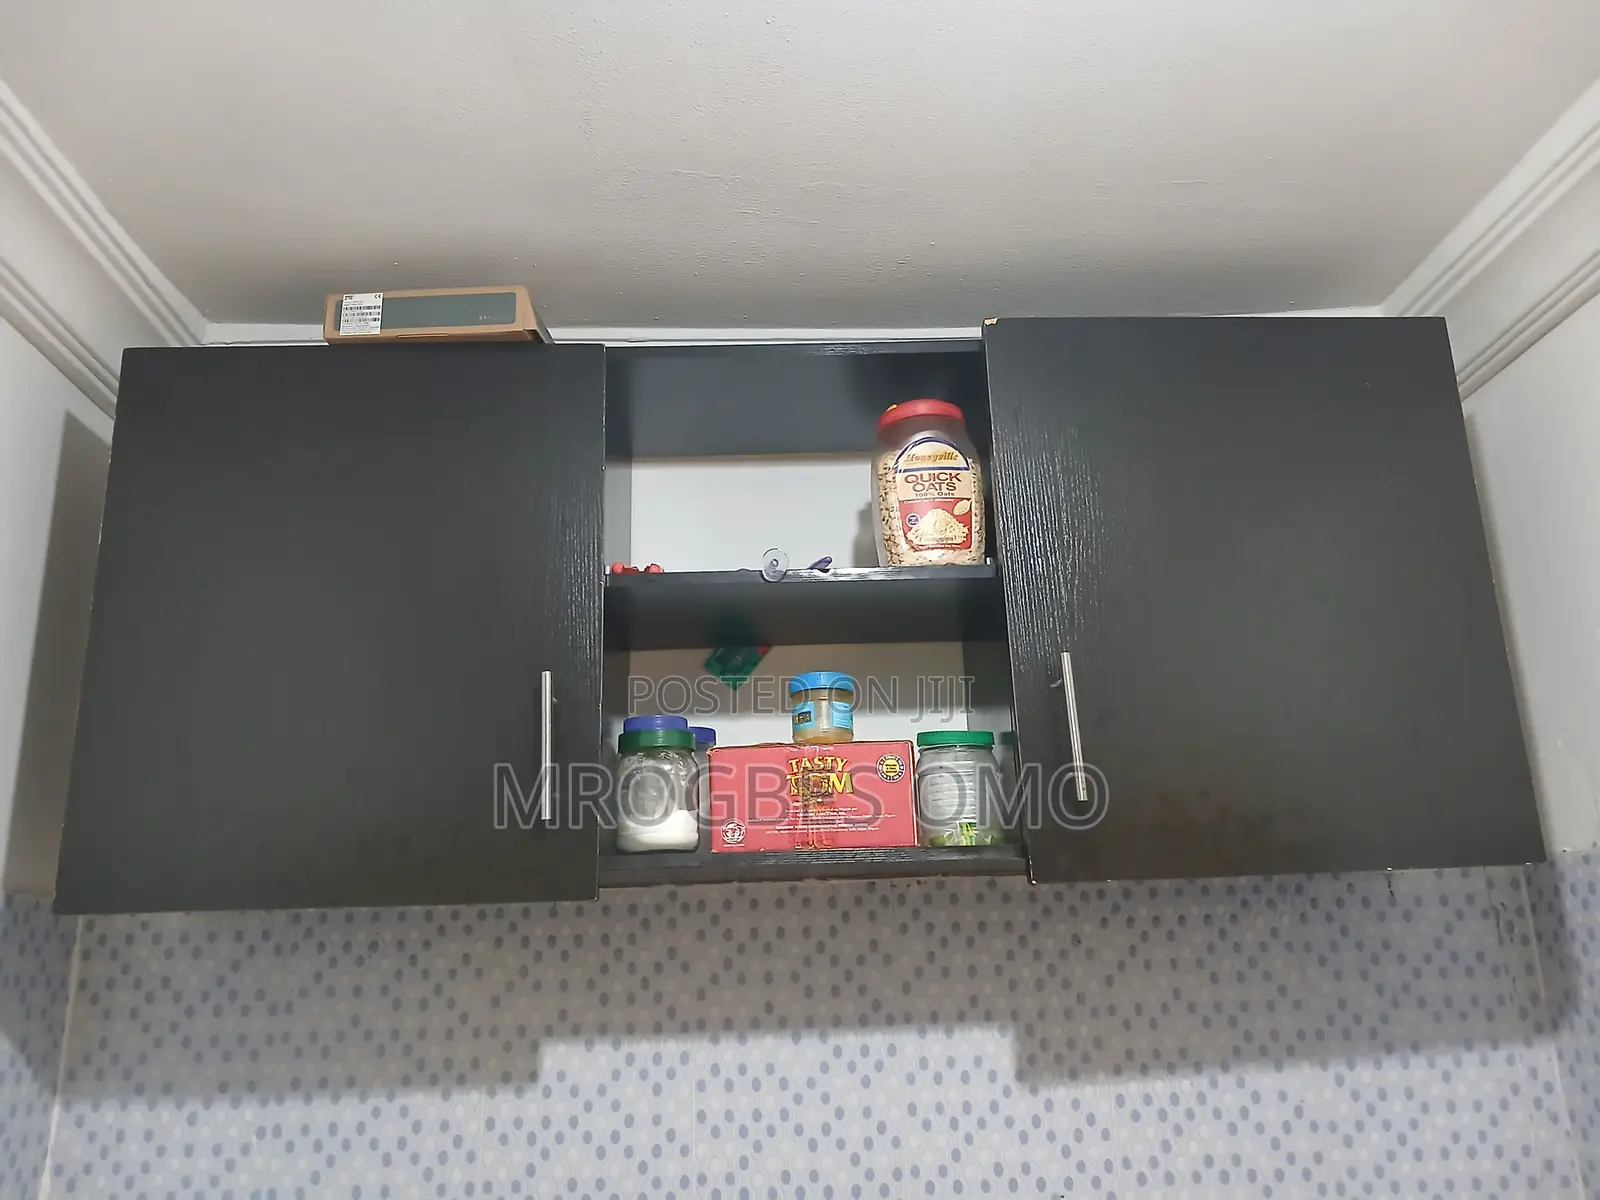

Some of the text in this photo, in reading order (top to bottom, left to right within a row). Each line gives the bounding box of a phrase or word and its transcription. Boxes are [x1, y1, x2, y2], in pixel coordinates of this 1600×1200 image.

[904, 472, 962, 483] QUICK
[912, 482, 957, 492] OATS
[788, 755, 849, 773] TASTY
